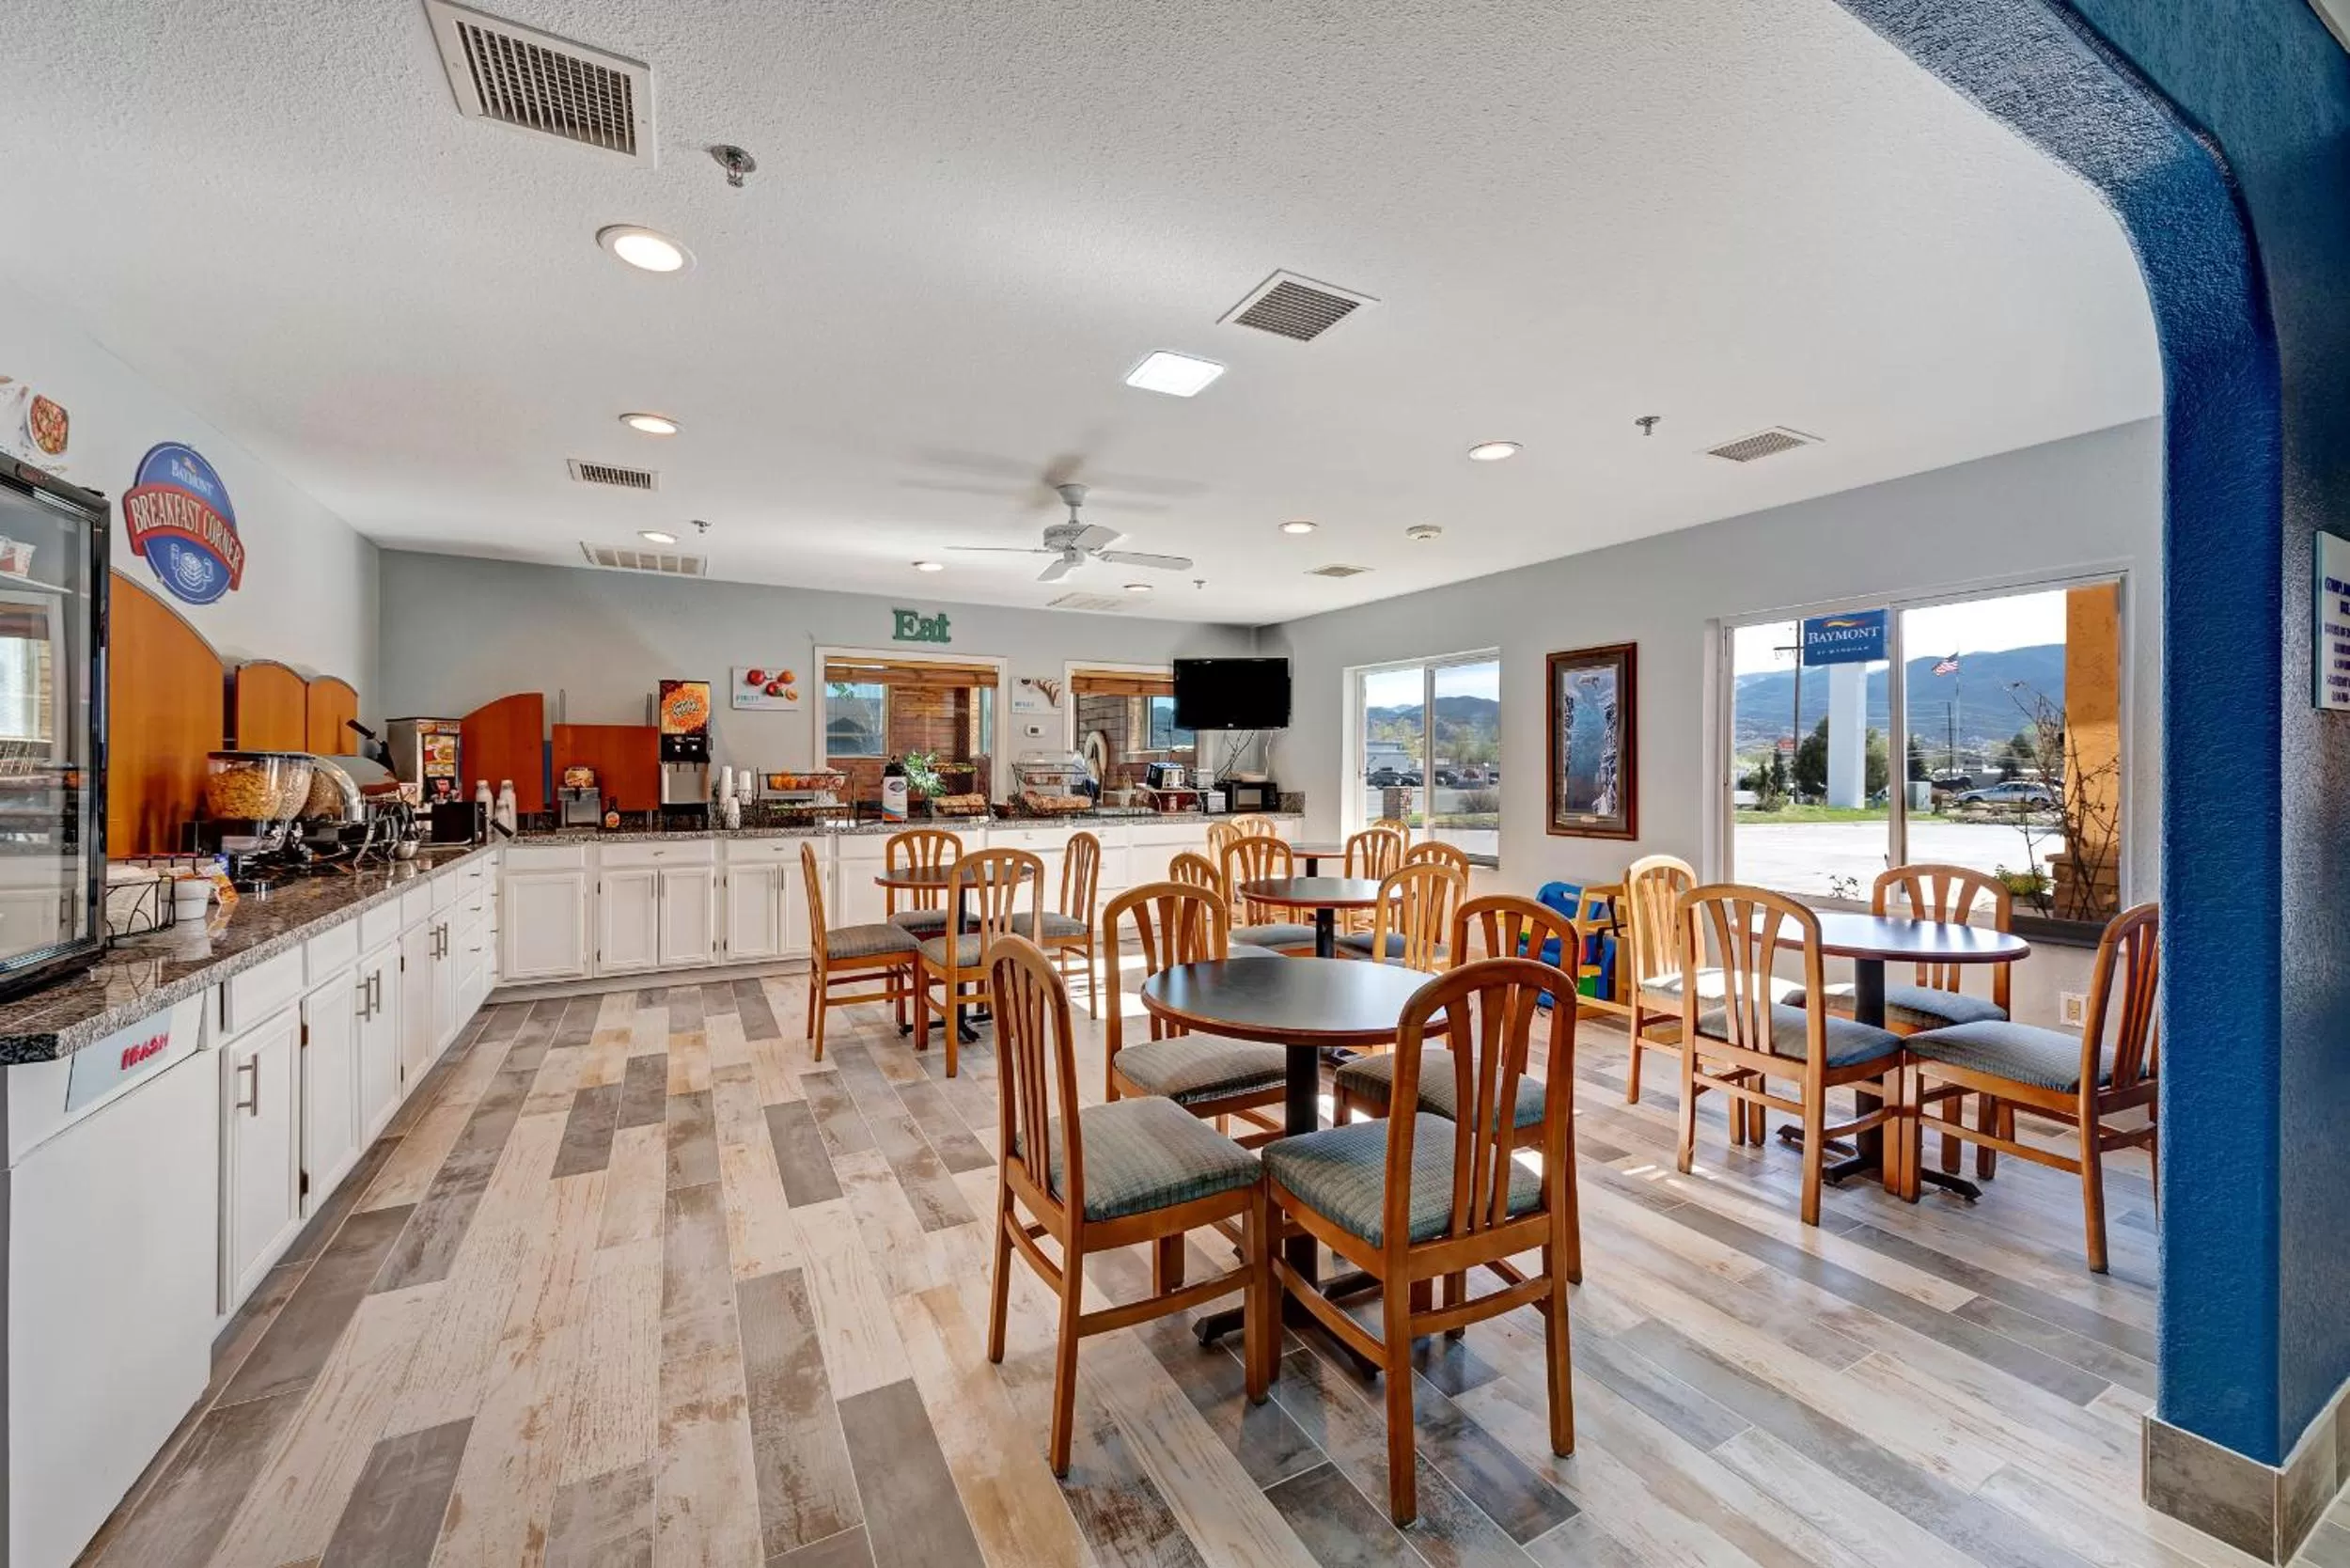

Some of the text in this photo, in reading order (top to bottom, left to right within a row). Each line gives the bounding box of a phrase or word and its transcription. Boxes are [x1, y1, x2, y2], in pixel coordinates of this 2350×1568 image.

[171, 458, 214, 495] BAYMONT
[130, 492, 242, 575] BREAKFAST CORNER
[892, 609, 951, 643] Eat
[1808, 626, 1880, 644] BAYMONT
[121, 1033, 169, 1071] TRASH
